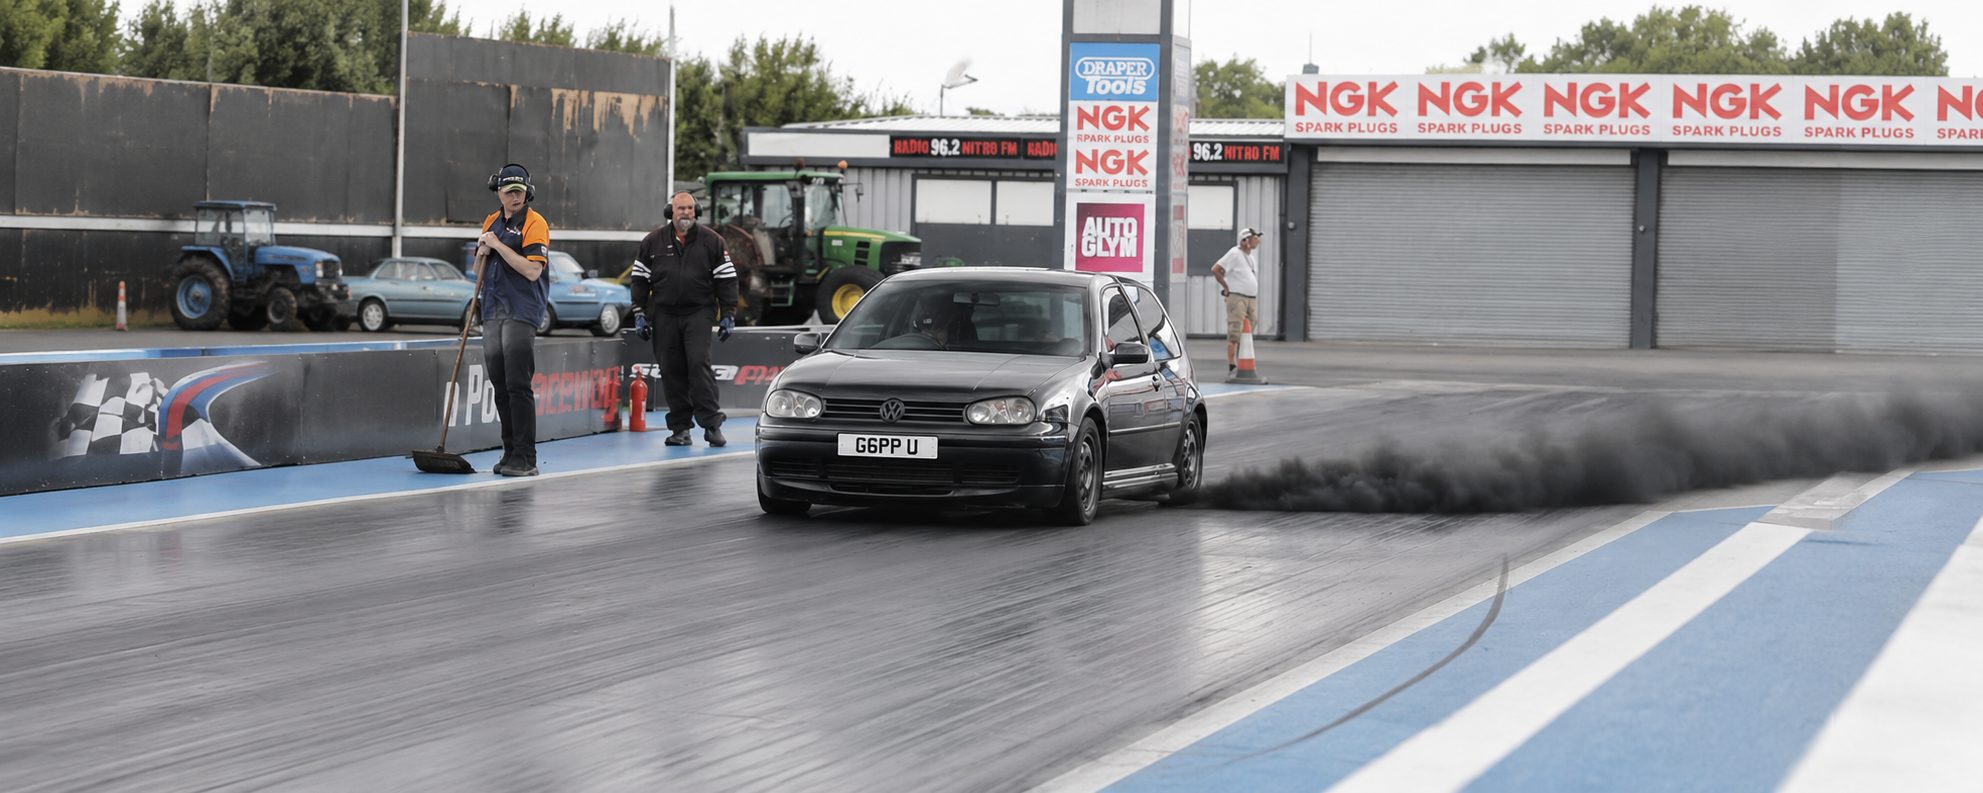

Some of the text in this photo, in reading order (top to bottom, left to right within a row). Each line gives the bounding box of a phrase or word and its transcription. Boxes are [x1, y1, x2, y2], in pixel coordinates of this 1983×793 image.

[1083, 61, 1148, 76] DRAPER
[1085, 76, 1147, 95] Tools
[1296, 81, 1399, 118] NGK
[1418, 81, 1522, 118] NGK
[1544, 82, 1651, 120] NGK
[1672, 82, 1782, 121] NGK
[1804, 84, 1915, 122] NGK
[1076, 105, 1150, 132] NGK
[1295, 121, 1399, 135] SPARK PLUGS
[1418, 122, 1522, 136] SPARK PLUGS
[1544, 122, 1651, 137] SPARK PLUGS
[1672, 124, 1782, 139] SPARK PLUGS
[1804, 126, 1915, 141] SPARK PLUGS
[894, 138, 1018, 156] RADIO 96.2 NITRO FM
[1114, 134, 1149, 144] PLUGS
[1193, 142, 1280, 161] 96.2 NITRO FM
[1075, 149, 1149, 176] NGK
[1075, 178, 1148, 188] SPARK PLUGS
[1082, 217, 1138, 237] AUTO
[1081, 236, 1138, 258] GLYM
[465, 364, 502, 426] Po
[856, 437, 918, 456] G6PP U
